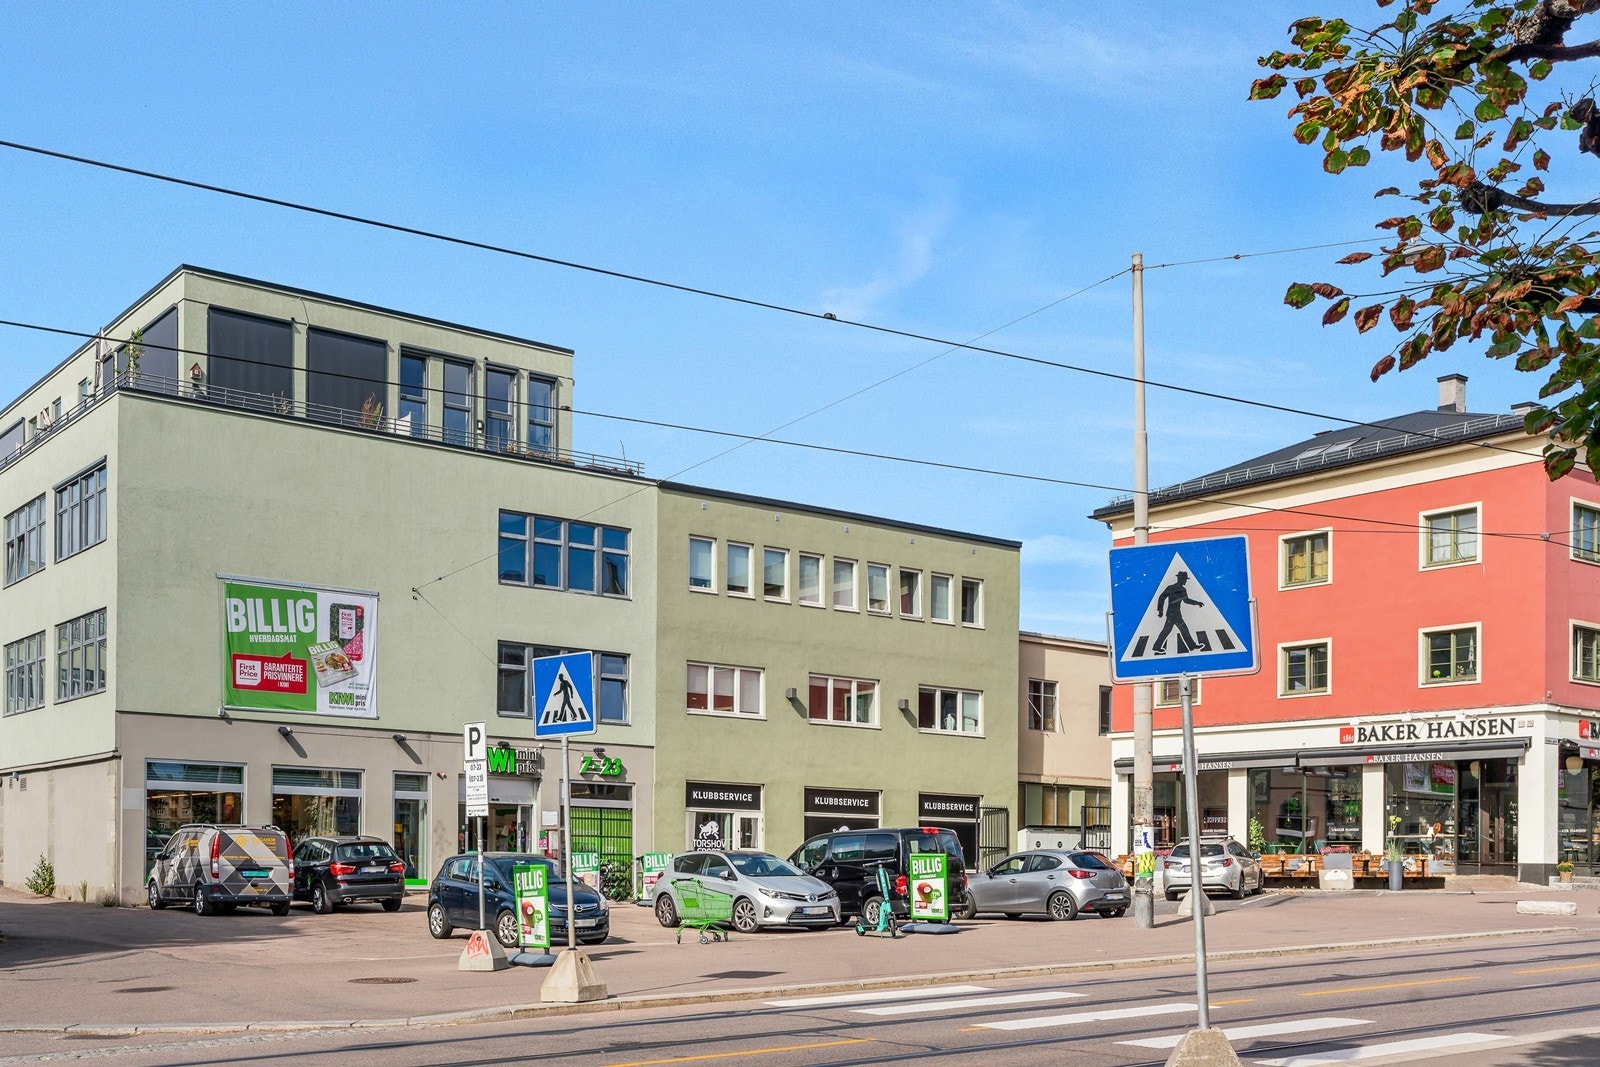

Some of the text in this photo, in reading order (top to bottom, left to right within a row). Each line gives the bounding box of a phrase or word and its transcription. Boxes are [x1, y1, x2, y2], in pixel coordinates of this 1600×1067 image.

[226, 598, 315, 633] BILLIG
[249, 634, 297, 643] HVERDAGSMAT
[308, 641, 339, 655] BILLIG
[239, 663, 256, 671] First
[263, 662, 304, 674] GARANTERTE
[263, 671, 304, 682] PRISVINNERE
[329, 691, 355, 706] KIWI
[355, 699, 366, 707] pris
[1357, 724, 1420, 743] BAKER
[1427, 717, 1516, 739] HANSEN
[468, 726, 481, 757] P
[486, 747, 516, 773] WI
[516, 748, 538, 760] mini
[1373, 752, 1444, 763] BAKER HANSEN
[516, 761, 536, 775] pris
[1201, 761, 1233, 770] HANSEN
[692, 790, 753, 802] KLUBBSERVICE
[814, 796, 869, 808] KLUBBSERVICE
[924, 801, 974, 812] KLUBBSERVICE
[912, 857, 943, 875] BILLIG
[515, 870, 543, 891] BILLIG
